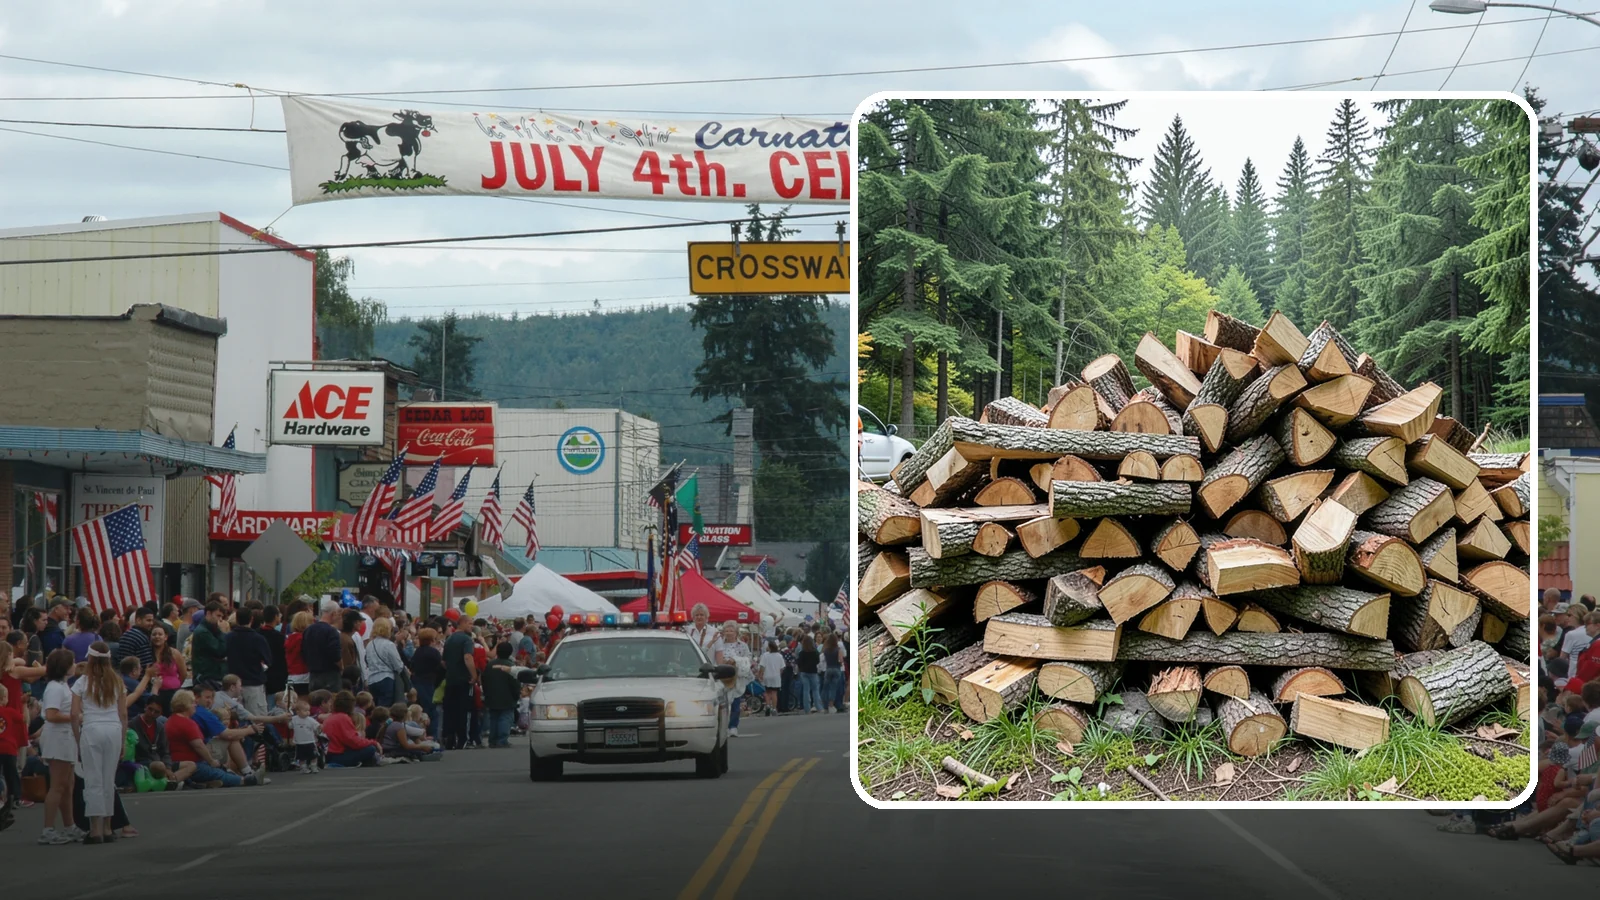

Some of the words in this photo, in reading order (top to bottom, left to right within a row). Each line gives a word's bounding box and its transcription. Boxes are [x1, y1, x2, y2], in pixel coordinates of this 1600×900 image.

[481, 141, 604, 192] JULY
[632, 150, 746, 197] 4th.
[697, 254, 850, 280] CROSSWA
[282, 380, 373, 420] ACE
[405, 409, 452, 422] CEDAR
[283, 421, 370, 436] Hardware
[83, 485, 93, 493] St.
[95, 485, 123, 494] Vincent
[126, 486, 135, 494] de
[138, 486, 154, 495] Paul
[688, 526, 741, 535] CRNATION
